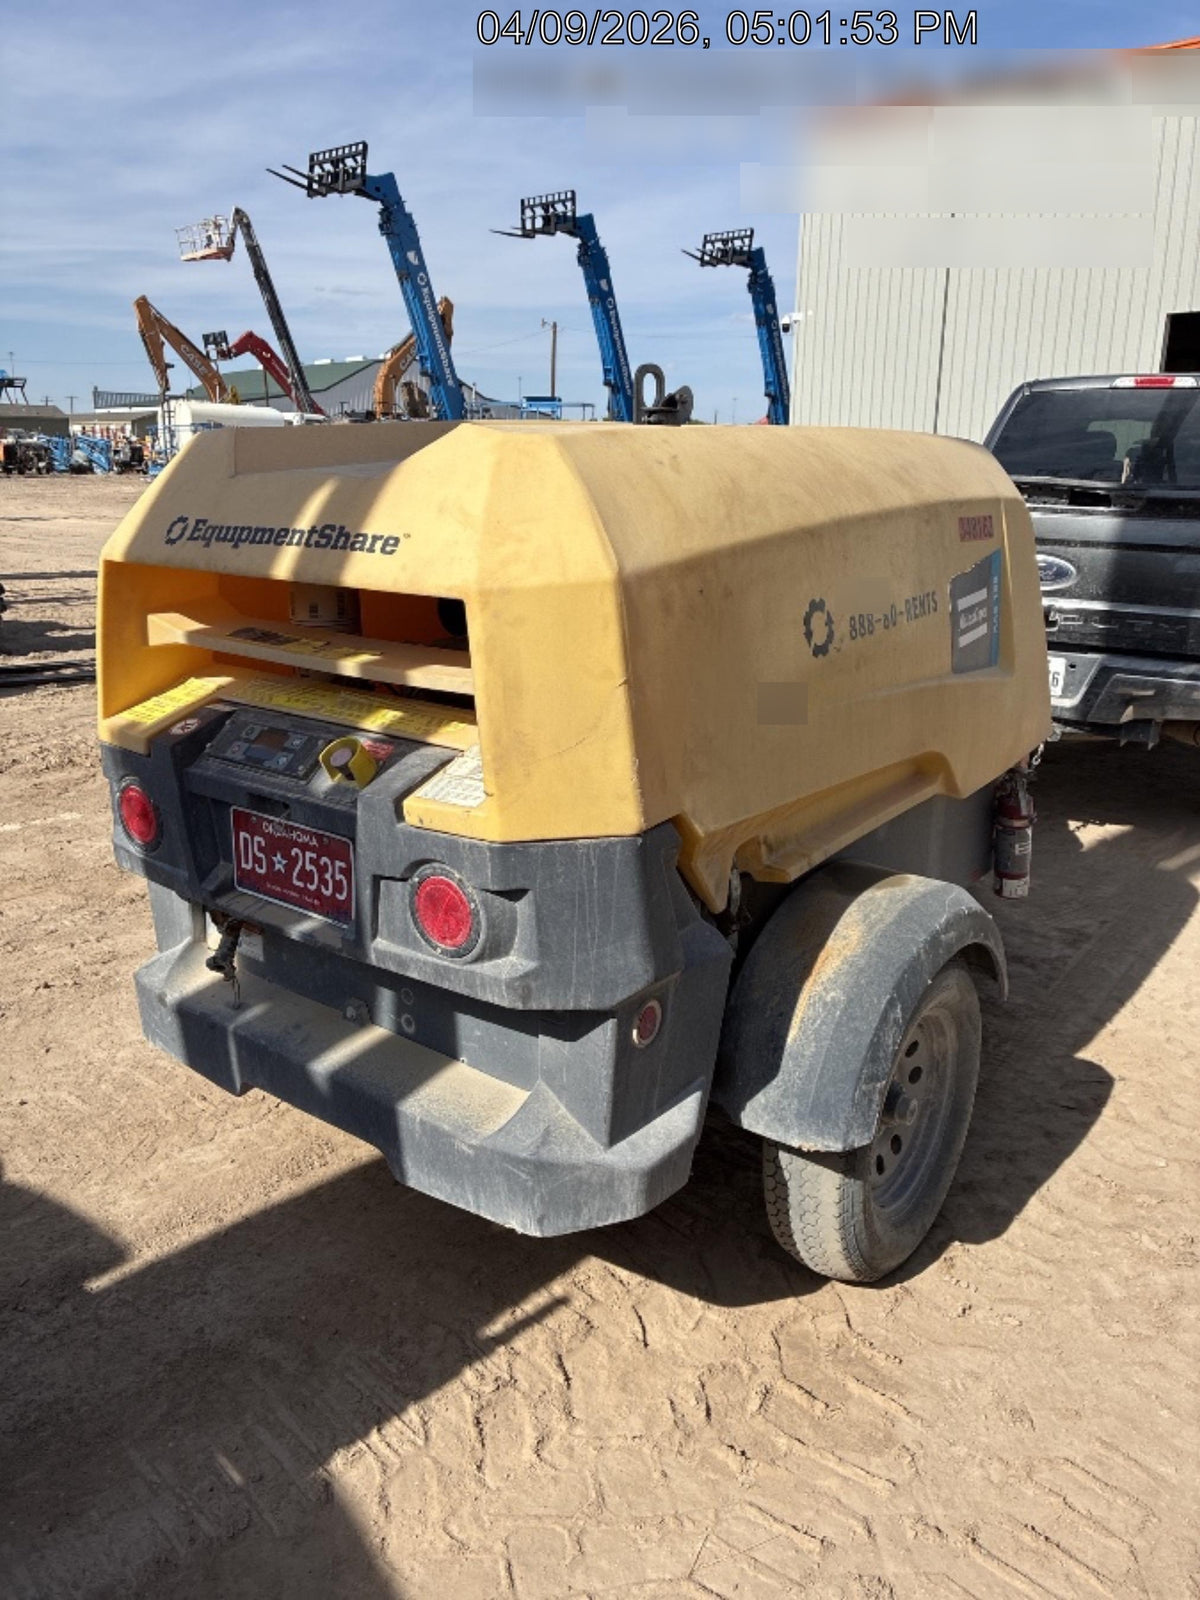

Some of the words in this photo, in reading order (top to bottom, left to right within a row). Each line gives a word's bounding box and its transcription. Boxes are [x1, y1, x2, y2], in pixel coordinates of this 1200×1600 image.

[187, 518, 400, 556] EquipmentShare
[239, 831, 267, 875] DS
[291, 847, 348, 900] 2535
